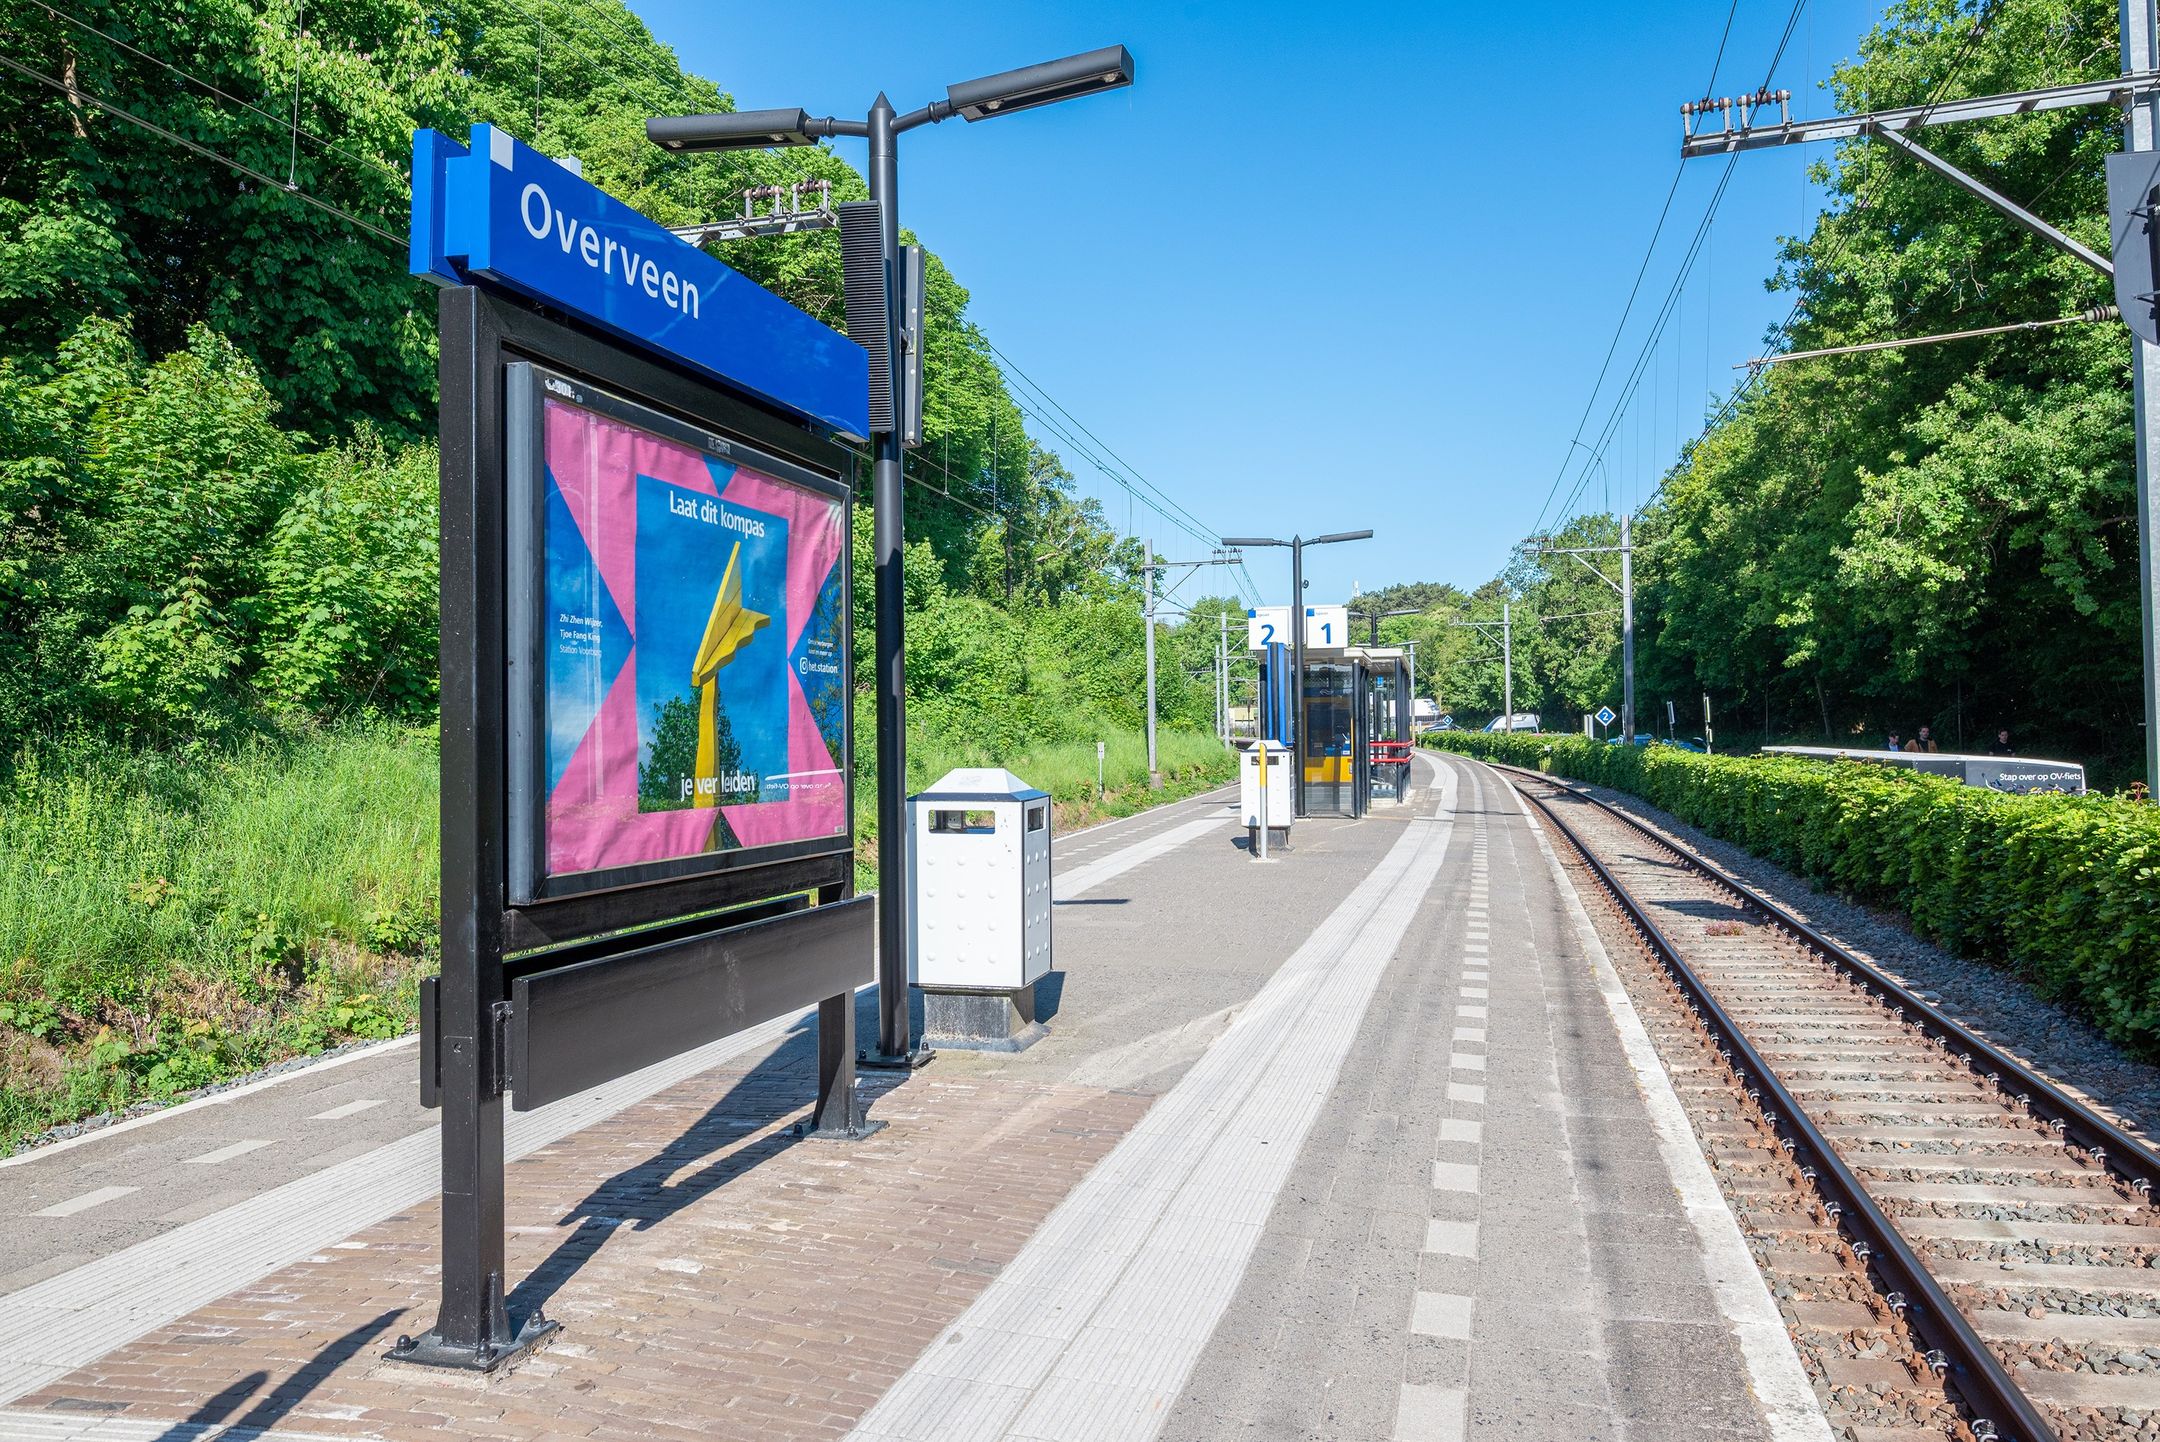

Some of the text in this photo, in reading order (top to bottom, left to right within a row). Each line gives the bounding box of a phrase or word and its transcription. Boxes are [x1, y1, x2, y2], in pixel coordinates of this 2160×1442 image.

[521, 183, 699, 320] Overveen
[670, 490, 765, 540] Laat dit kompas
[560, 614, 569, 622] Zhi
[570, 615, 583, 624] Zhen
[560, 629, 572, 639] Tjoe
[573, 631, 587, 641] Fang
[1261, 624, 1275, 645] 2
[1321, 623, 1331, 644] 1
[560, 644, 578, 654] Station
[808, 660, 838, 674] het.station
[1602, 712, 1609, 721] 2
[2000, 773, 2017, 782] Stap
[2037, 774, 2048, 782] op
[680, 769, 756, 802] je ver leiden
